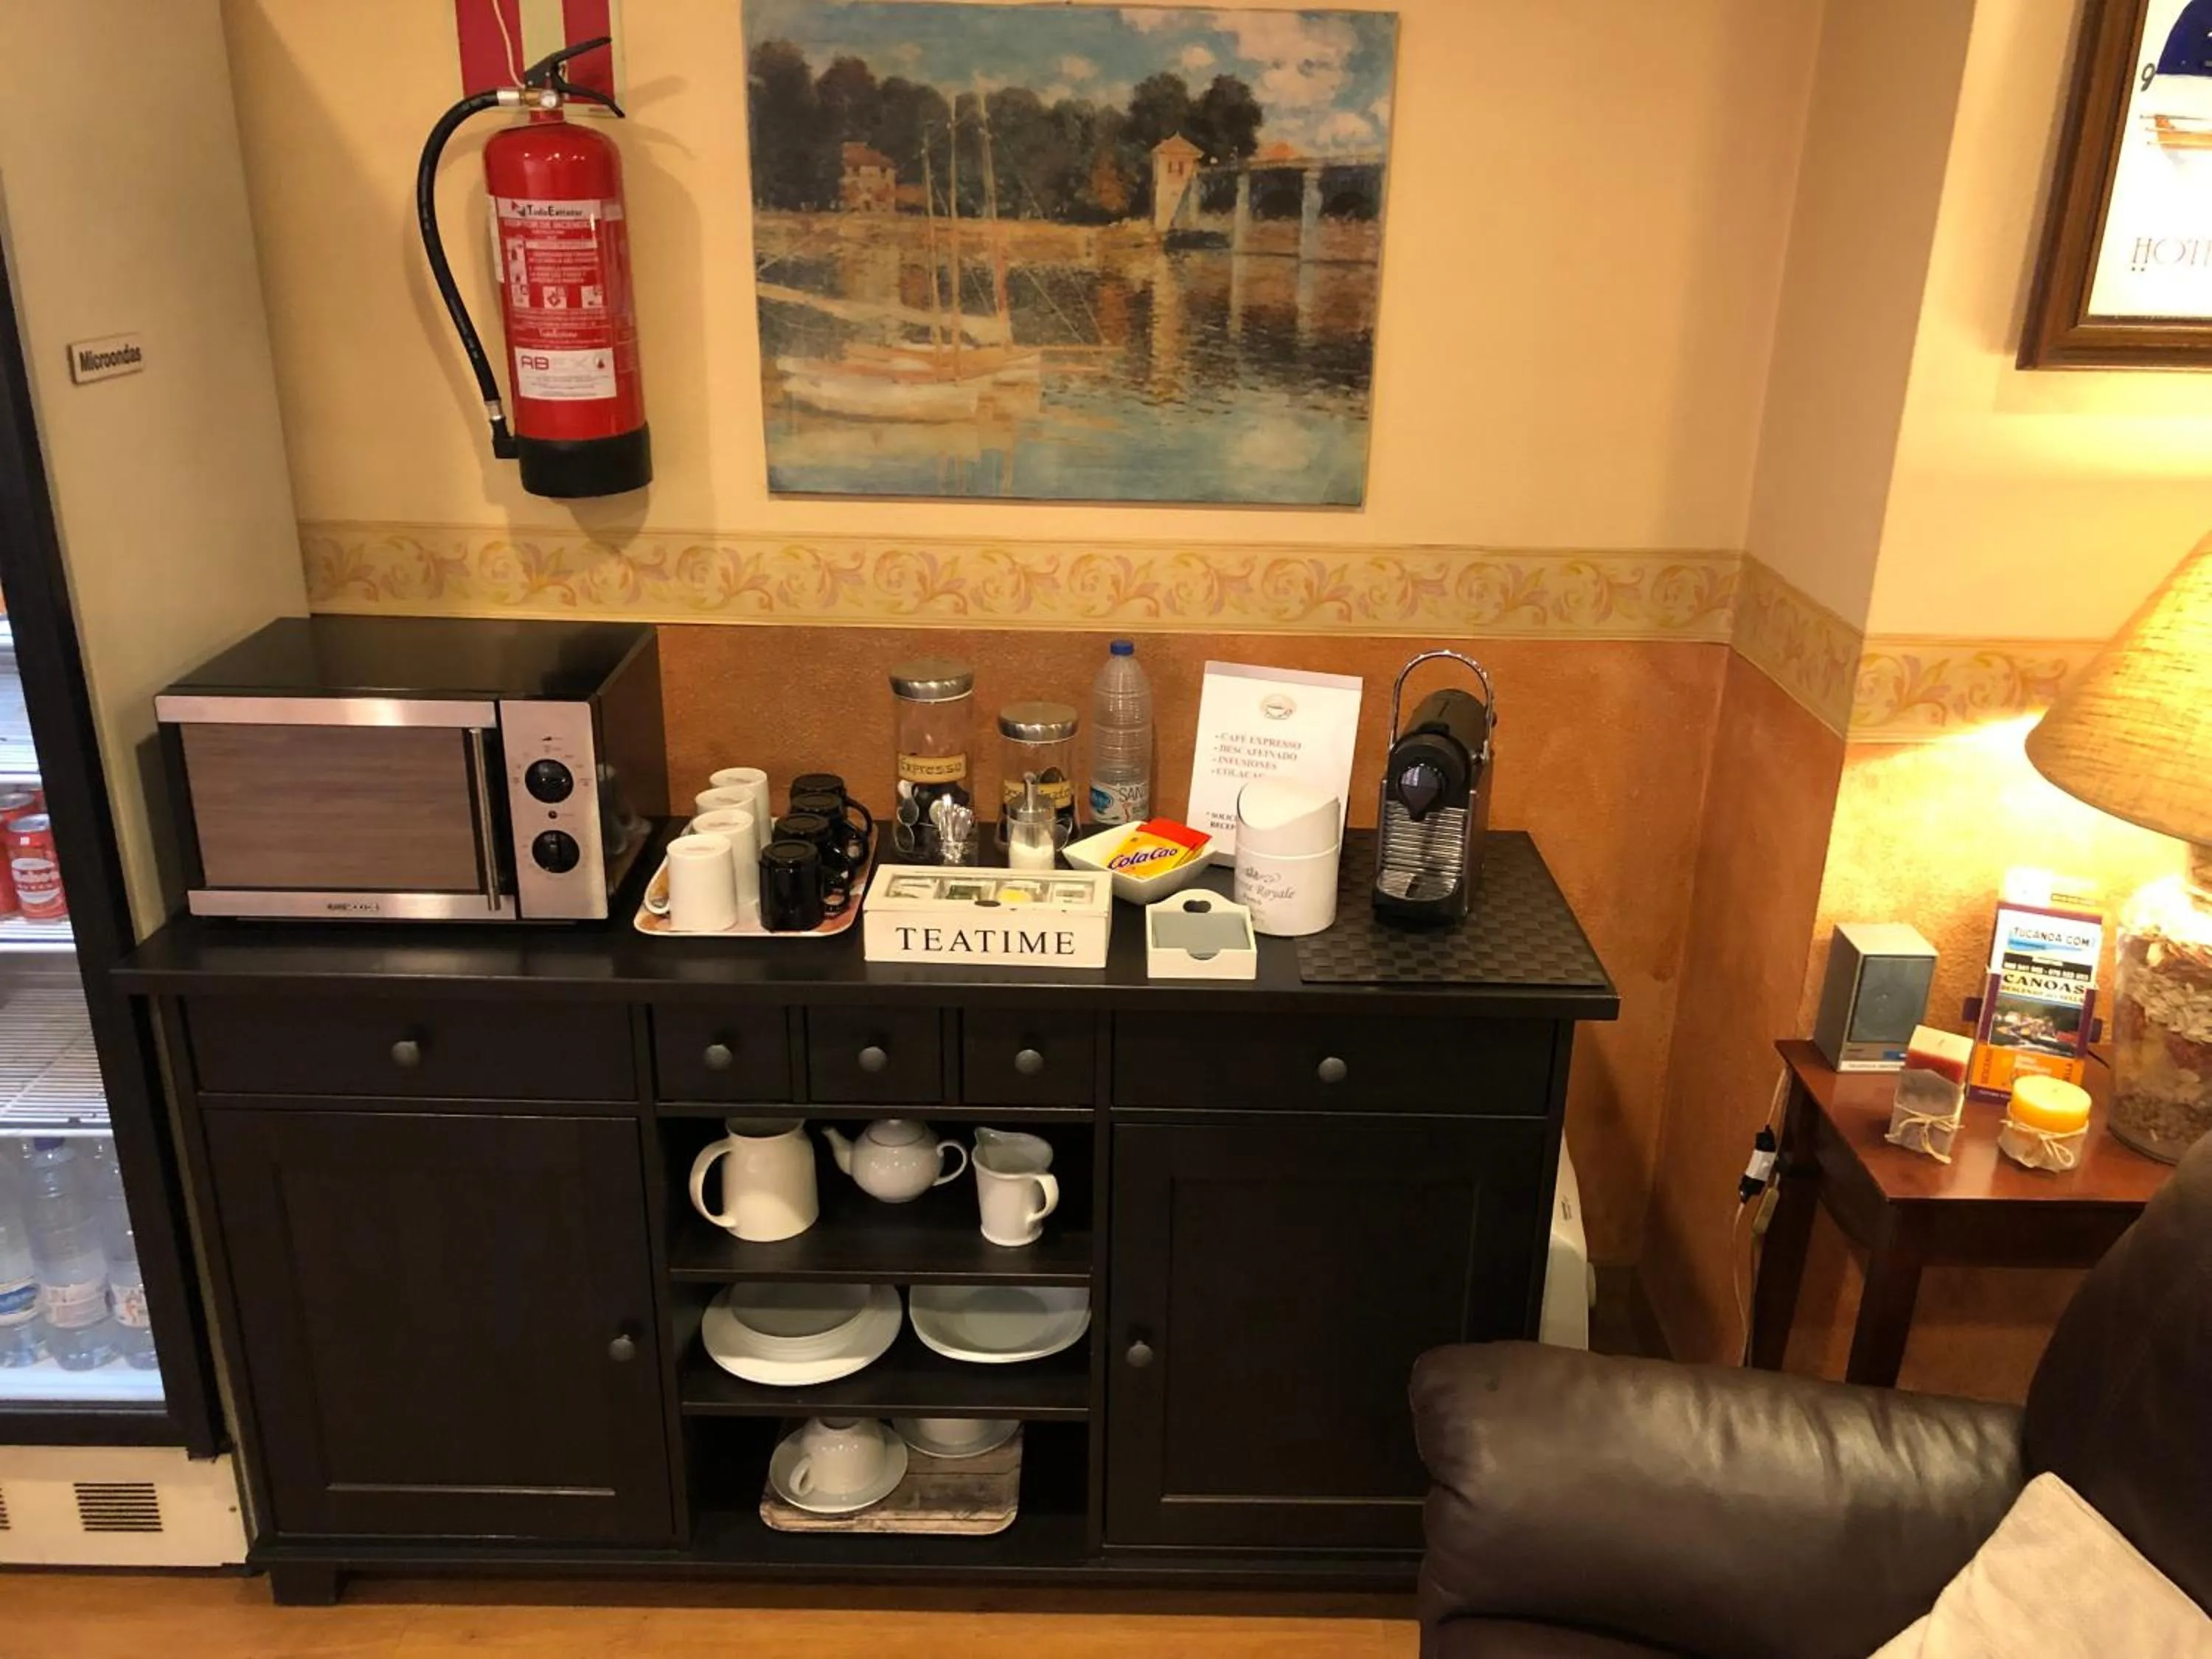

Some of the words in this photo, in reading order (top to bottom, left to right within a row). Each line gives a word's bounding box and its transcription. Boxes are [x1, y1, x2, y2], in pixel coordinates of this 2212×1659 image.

[79, 343, 142, 372] Microondas
[895, 926, 1076, 956] TEATIME
[2003, 973, 2086, 995] CANOAS
